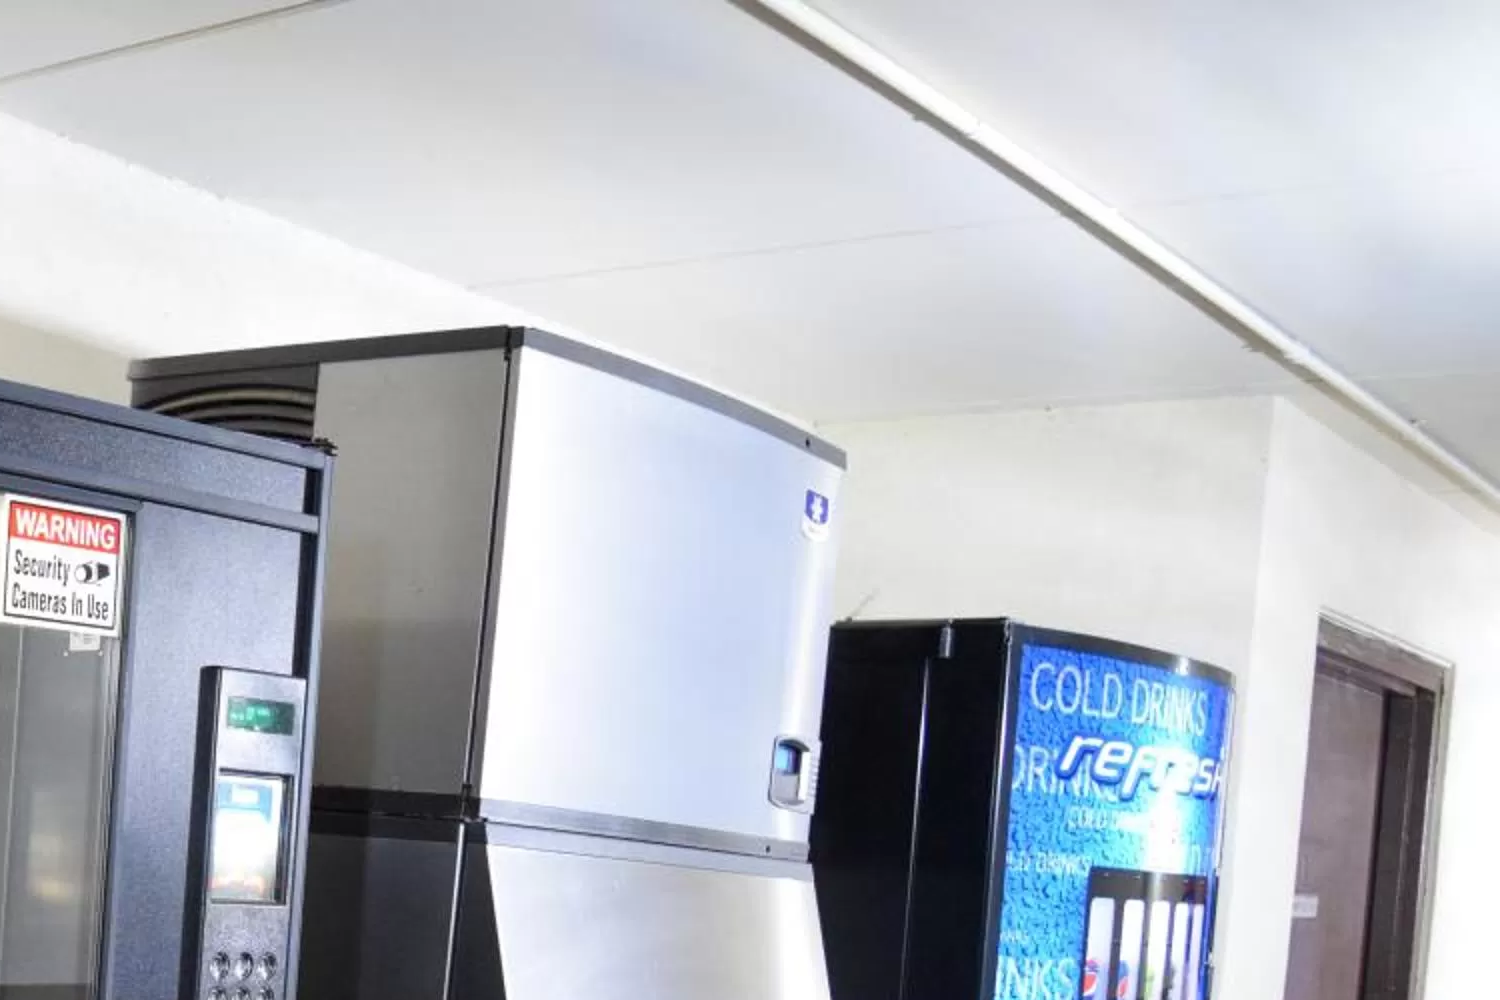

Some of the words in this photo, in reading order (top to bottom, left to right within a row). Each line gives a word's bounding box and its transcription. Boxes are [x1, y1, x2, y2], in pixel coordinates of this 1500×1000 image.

[14, 508, 115, 549] WARNING
[14, 549, 70, 586] Security
[12, 582, 67, 614] Cameras
[71, 592, 83, 616] In
[87, 594, 109, 621] Use
[1031, 663, 1123, 719] COLD
[1132, 679, 1207, 737] DRINKS
